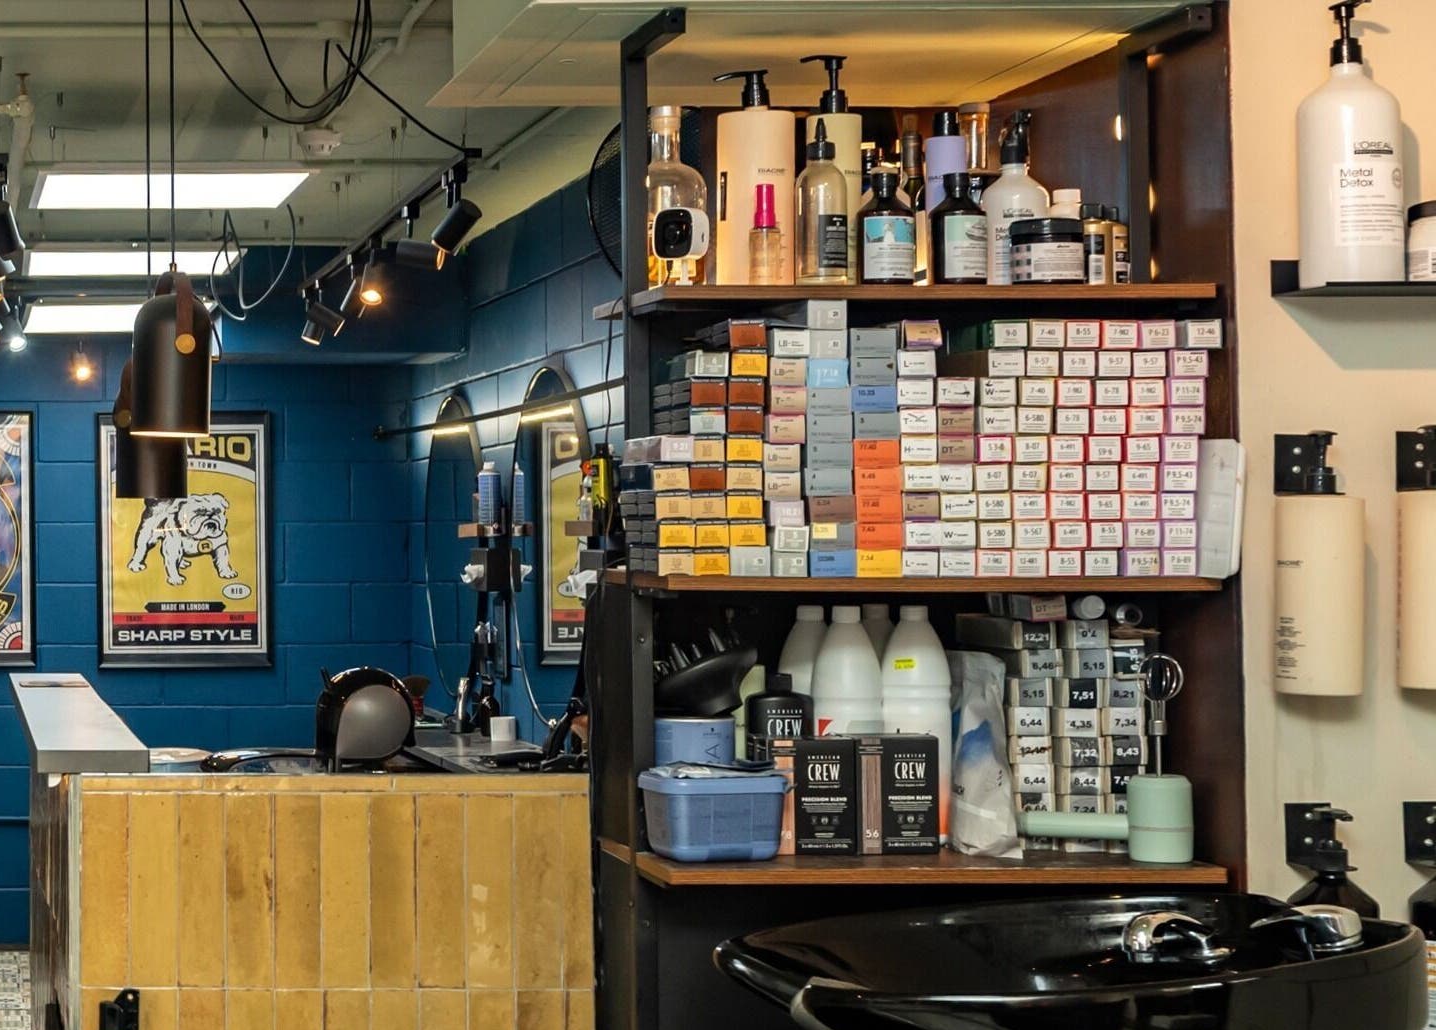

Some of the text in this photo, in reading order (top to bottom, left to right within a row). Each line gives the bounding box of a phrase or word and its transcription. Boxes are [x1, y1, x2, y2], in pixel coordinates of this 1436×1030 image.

[1340, 168, 1373, 177] Metal
[1340, 178, 1374, 188] Detox
[161, 603, 210, 611] MADE IN LONDON
[118, 629, 253, 641] SHARP STYLE
[1024, 632, 1050, 642] 12,21
[1083, 662, 1105, 671] 5,15
[1022, 690, 1044, 699] 5,15
[1072, 691, 1095, 700] 7,51
[767, 718, 803, 736] CREW
[1020, 718, 1042, 728] 6,44
[1069, 720, 1093, 730] 4,35
[1114, 718, 1137, 728] 7,34
[1116, 747, 1139, 757] 8,43
[807, 763, 841, 782] CREW
[894, 762, 926, 780] CREW
[1023, 776, 1046, 786] 6,44
[1074, 777, 1097, 787] 8,44
[865, 829, 880, 839] 56
